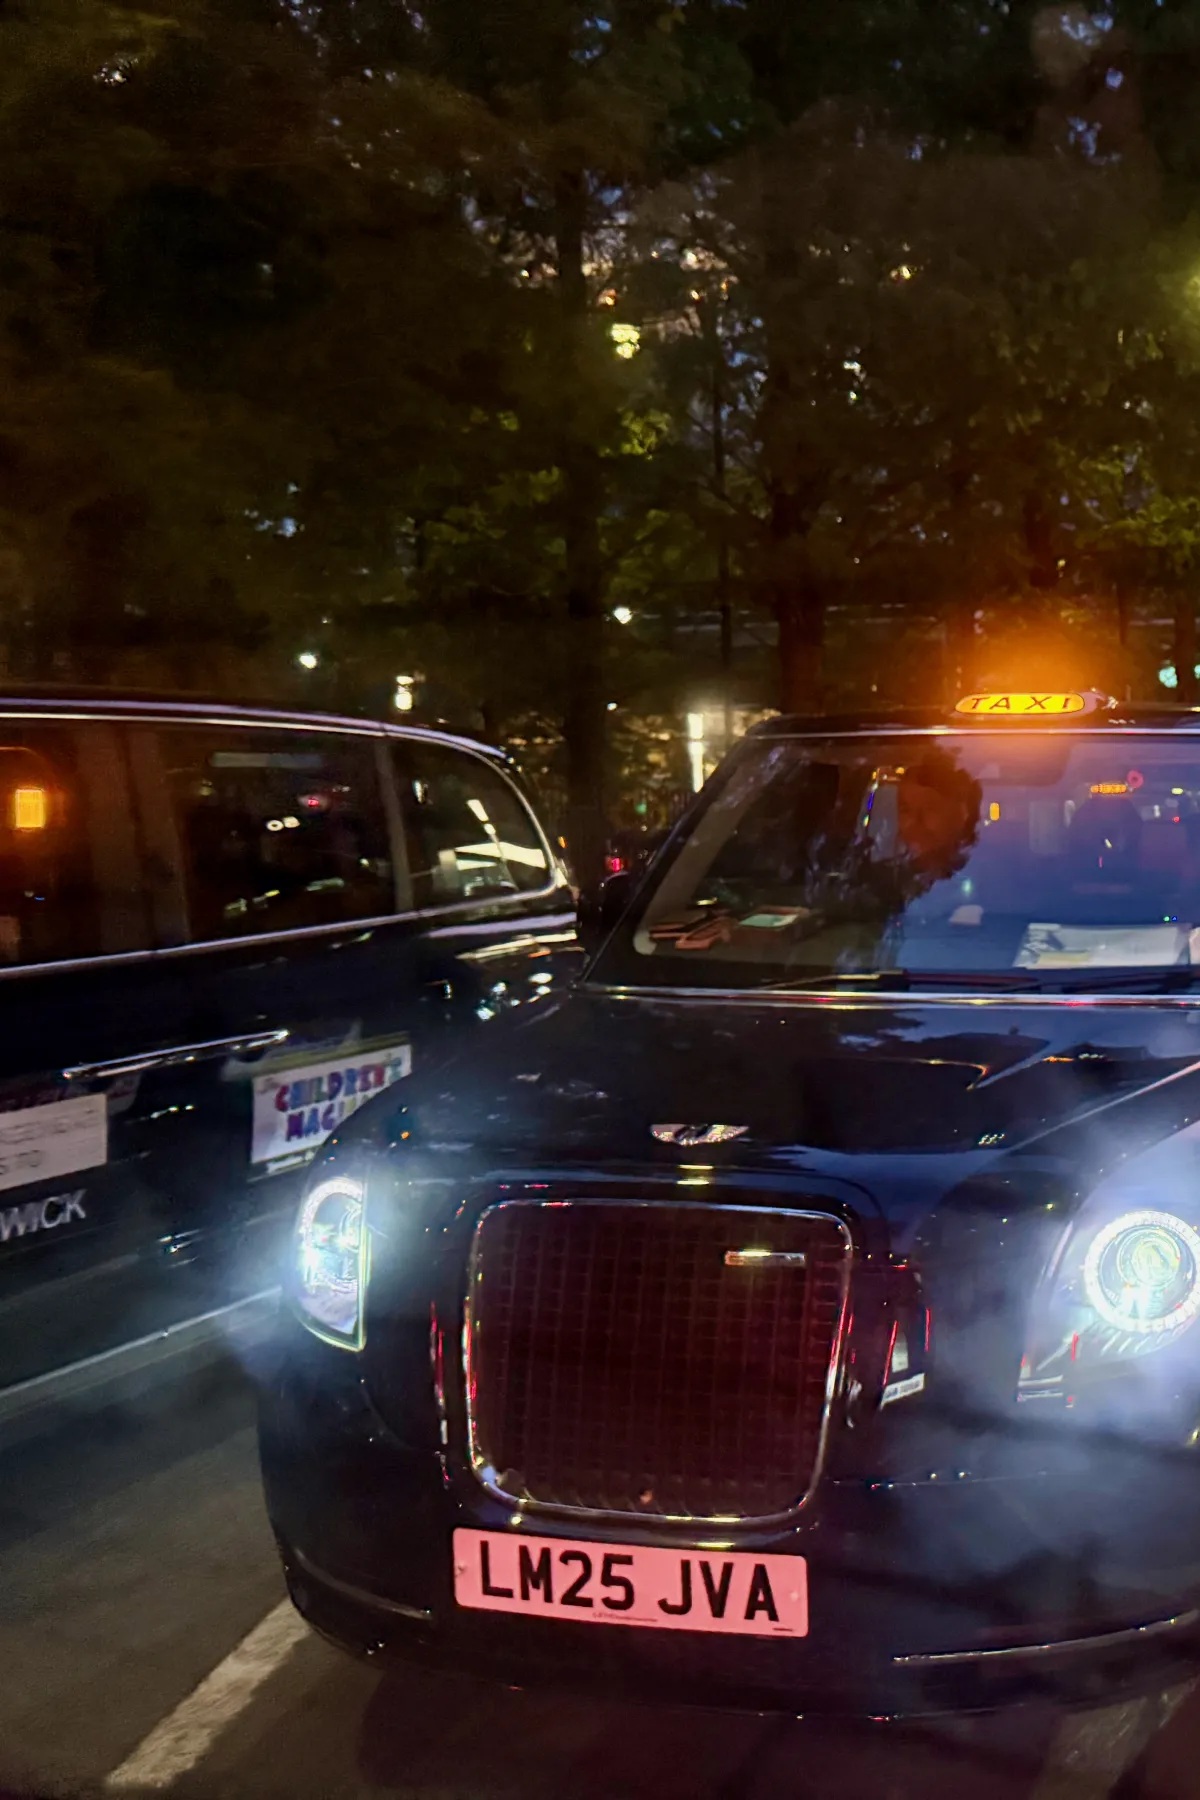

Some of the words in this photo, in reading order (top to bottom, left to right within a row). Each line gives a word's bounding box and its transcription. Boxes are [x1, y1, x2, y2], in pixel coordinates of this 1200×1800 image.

[970, 696, 1073, 711] TAXI
[480, 1540, 635, 1611] LM25
[657, 1558, 779, 1622] JVA
